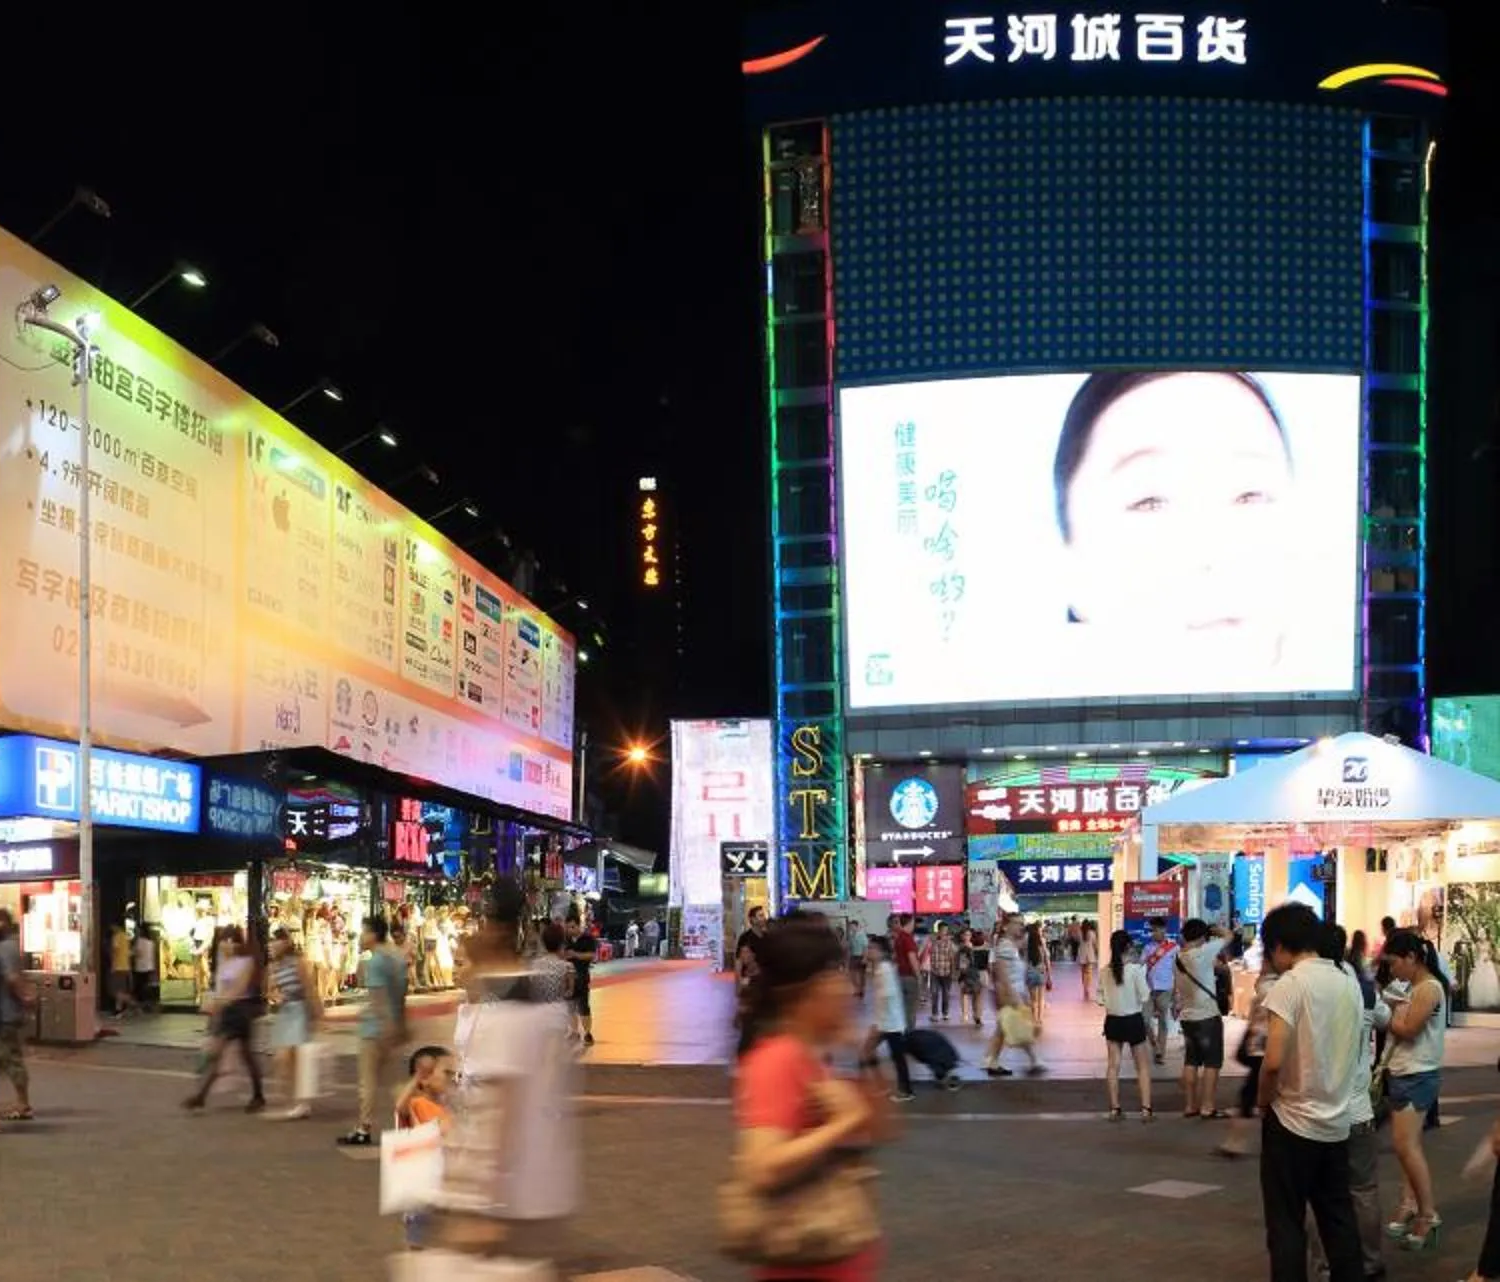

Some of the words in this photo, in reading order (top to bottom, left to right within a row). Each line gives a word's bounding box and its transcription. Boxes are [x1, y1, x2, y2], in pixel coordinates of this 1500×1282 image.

[944, 13, 1247, 66] 天河城百货
[1018, 863, 1115, 883] 天河城百
[1245, 862, 1263, 918] Suning
